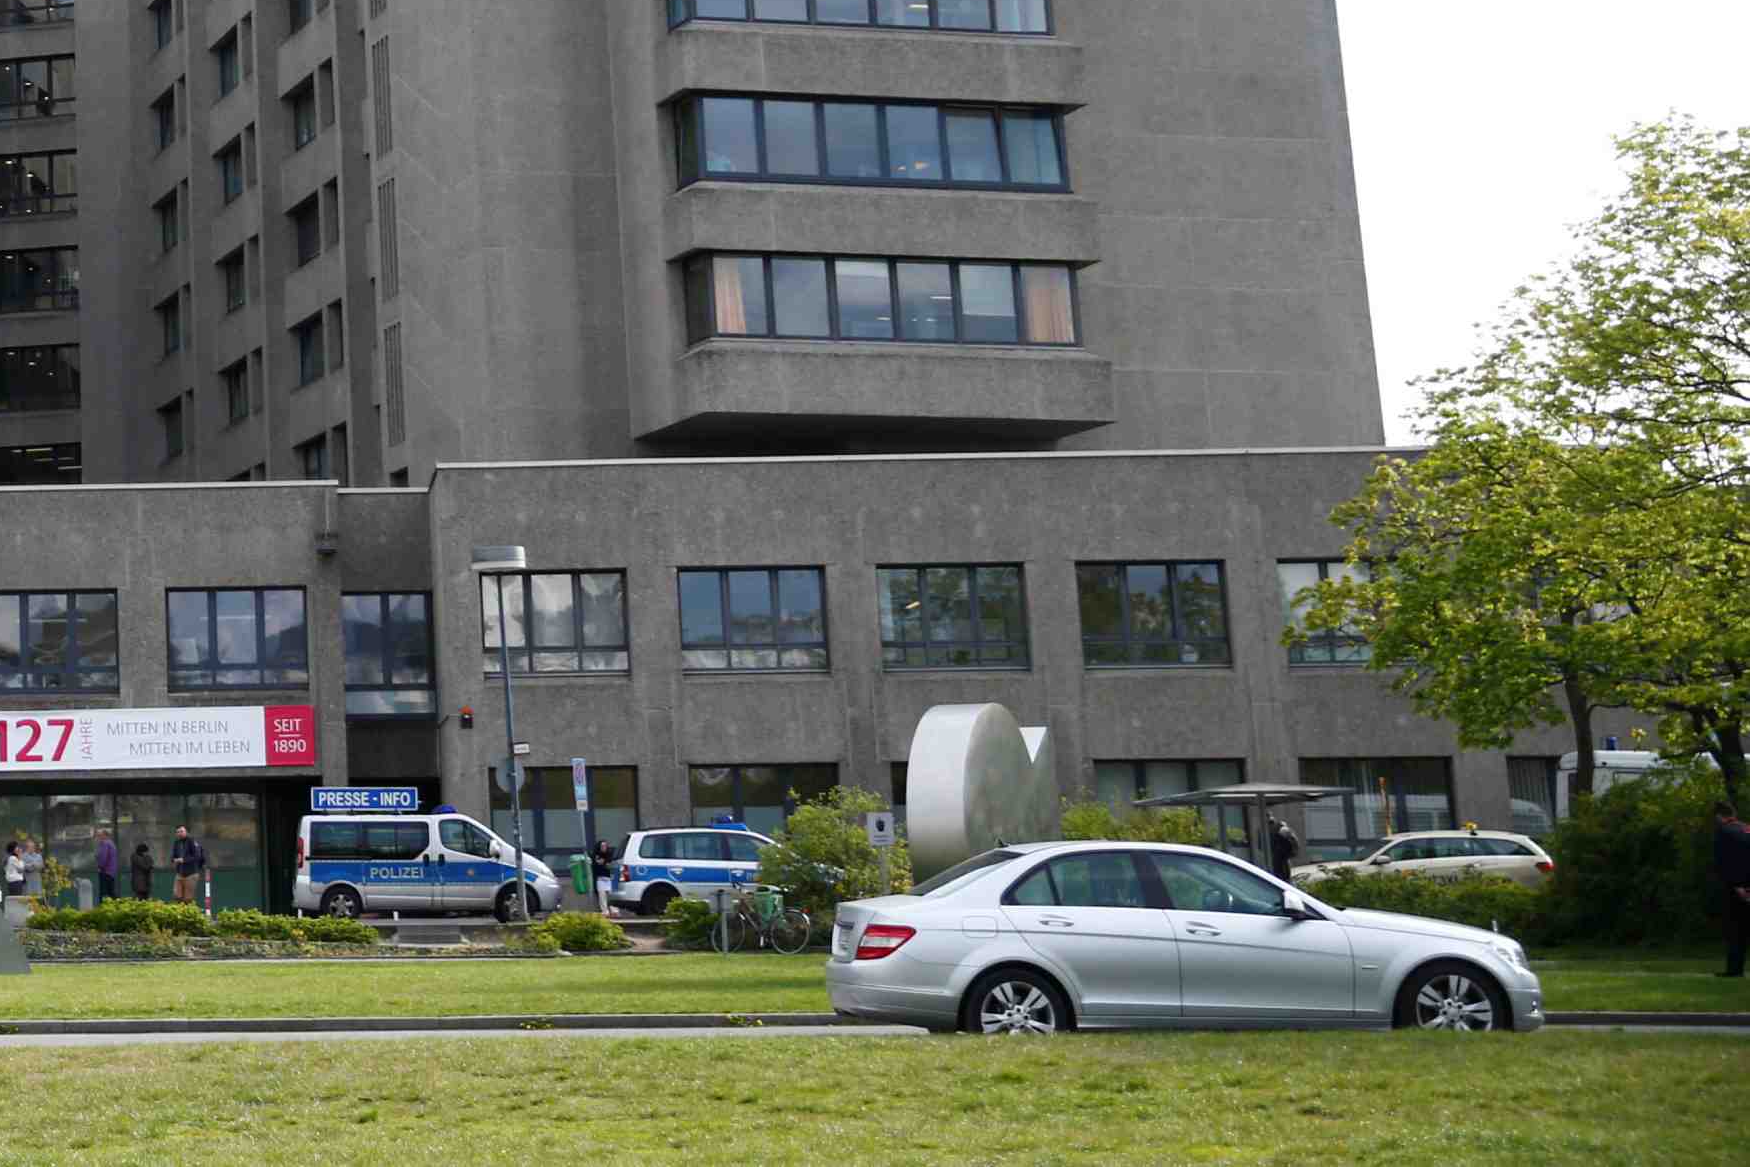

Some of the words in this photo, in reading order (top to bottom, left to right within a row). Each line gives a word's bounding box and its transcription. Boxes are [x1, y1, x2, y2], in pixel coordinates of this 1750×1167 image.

[107, 722, 158, 736] MITTEN
[163, 721, 177, 735] IN
[181, 720, 229, 734] BERLIN
[273, 718, 303, 733] SEIT
[79, 718, 92, 760] JAHRE
[129, 741, 182, 755] MITTEN
[185, 741, 203, 754] IM
[207, 739, 250, 753] LEBEN
[273, 738, 308, 753] 1890
[318, 791, 369, 807] PRESSE
[379, 791, 411, 806] INFO
[369, 866, 425, 879] POLIZEI
